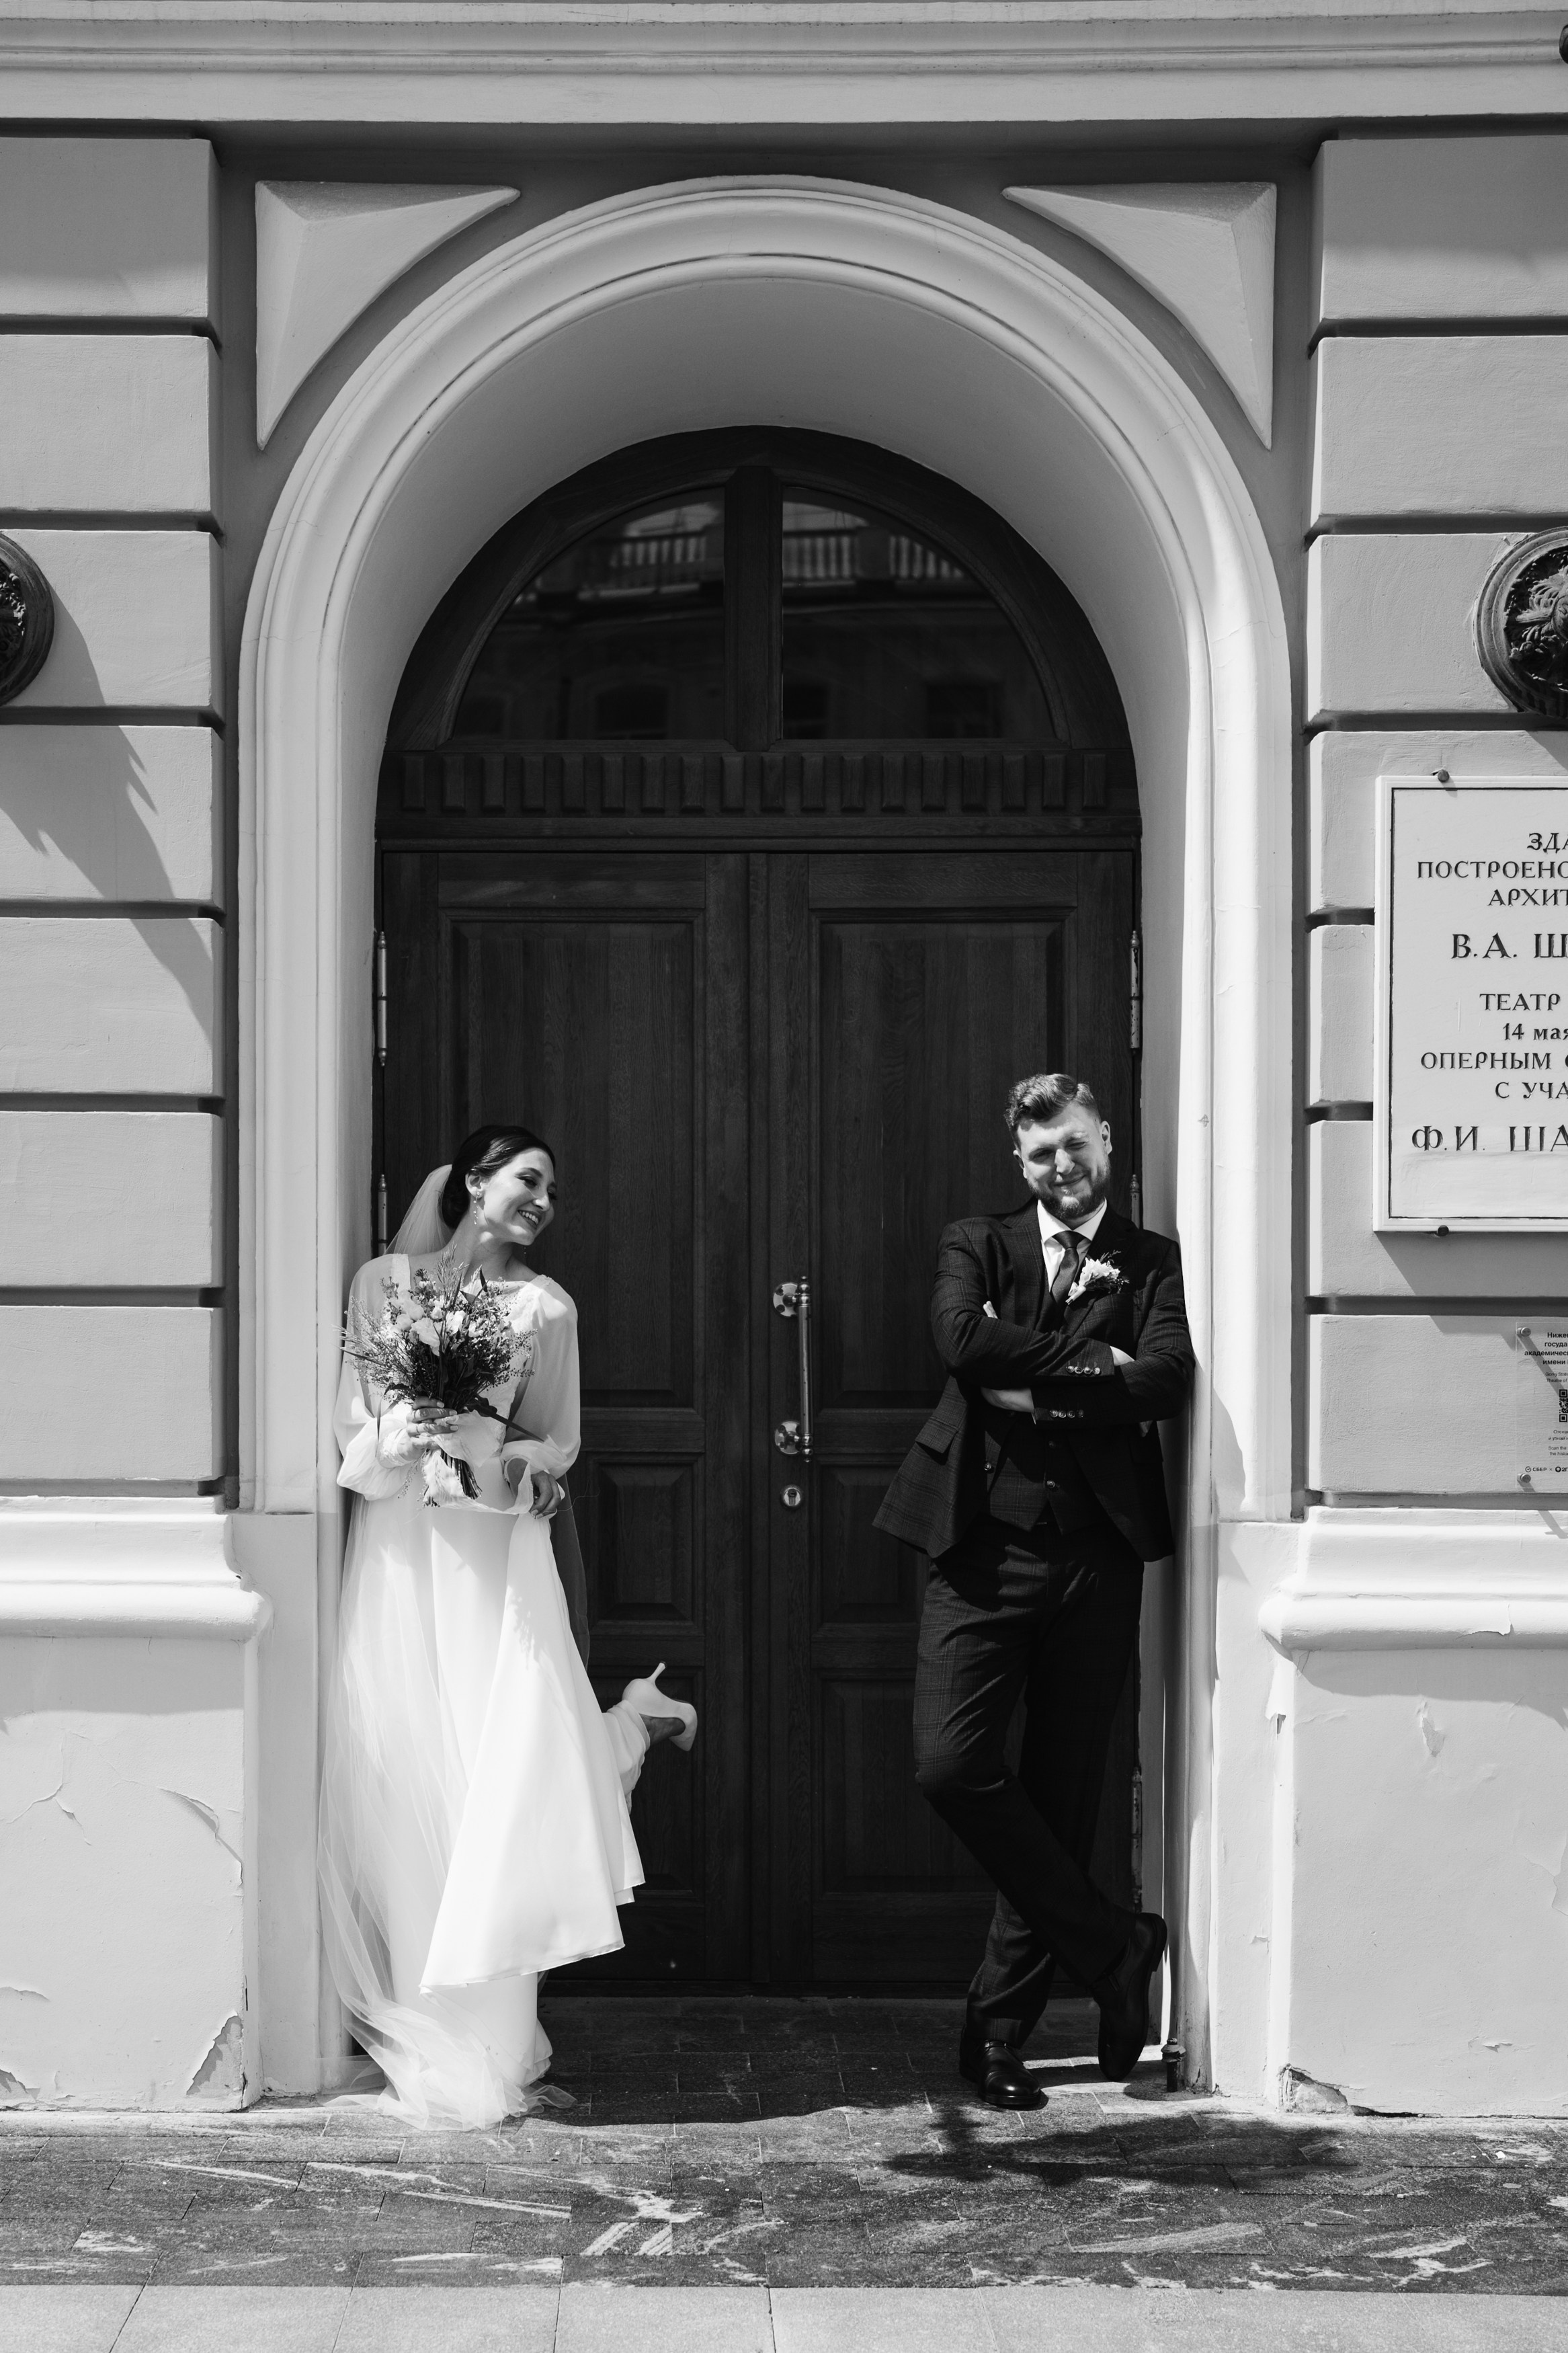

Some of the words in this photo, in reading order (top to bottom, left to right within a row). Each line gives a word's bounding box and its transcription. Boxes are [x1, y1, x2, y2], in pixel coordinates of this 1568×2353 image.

[1479, 992, 1561, 1011] ТЕАТР
[1502, 1023, 1525, 1041] 14
[1420, 1051, 1552, 1070] ОПЕРНЫМ
[1495, 1081, 1510, 1099] С
